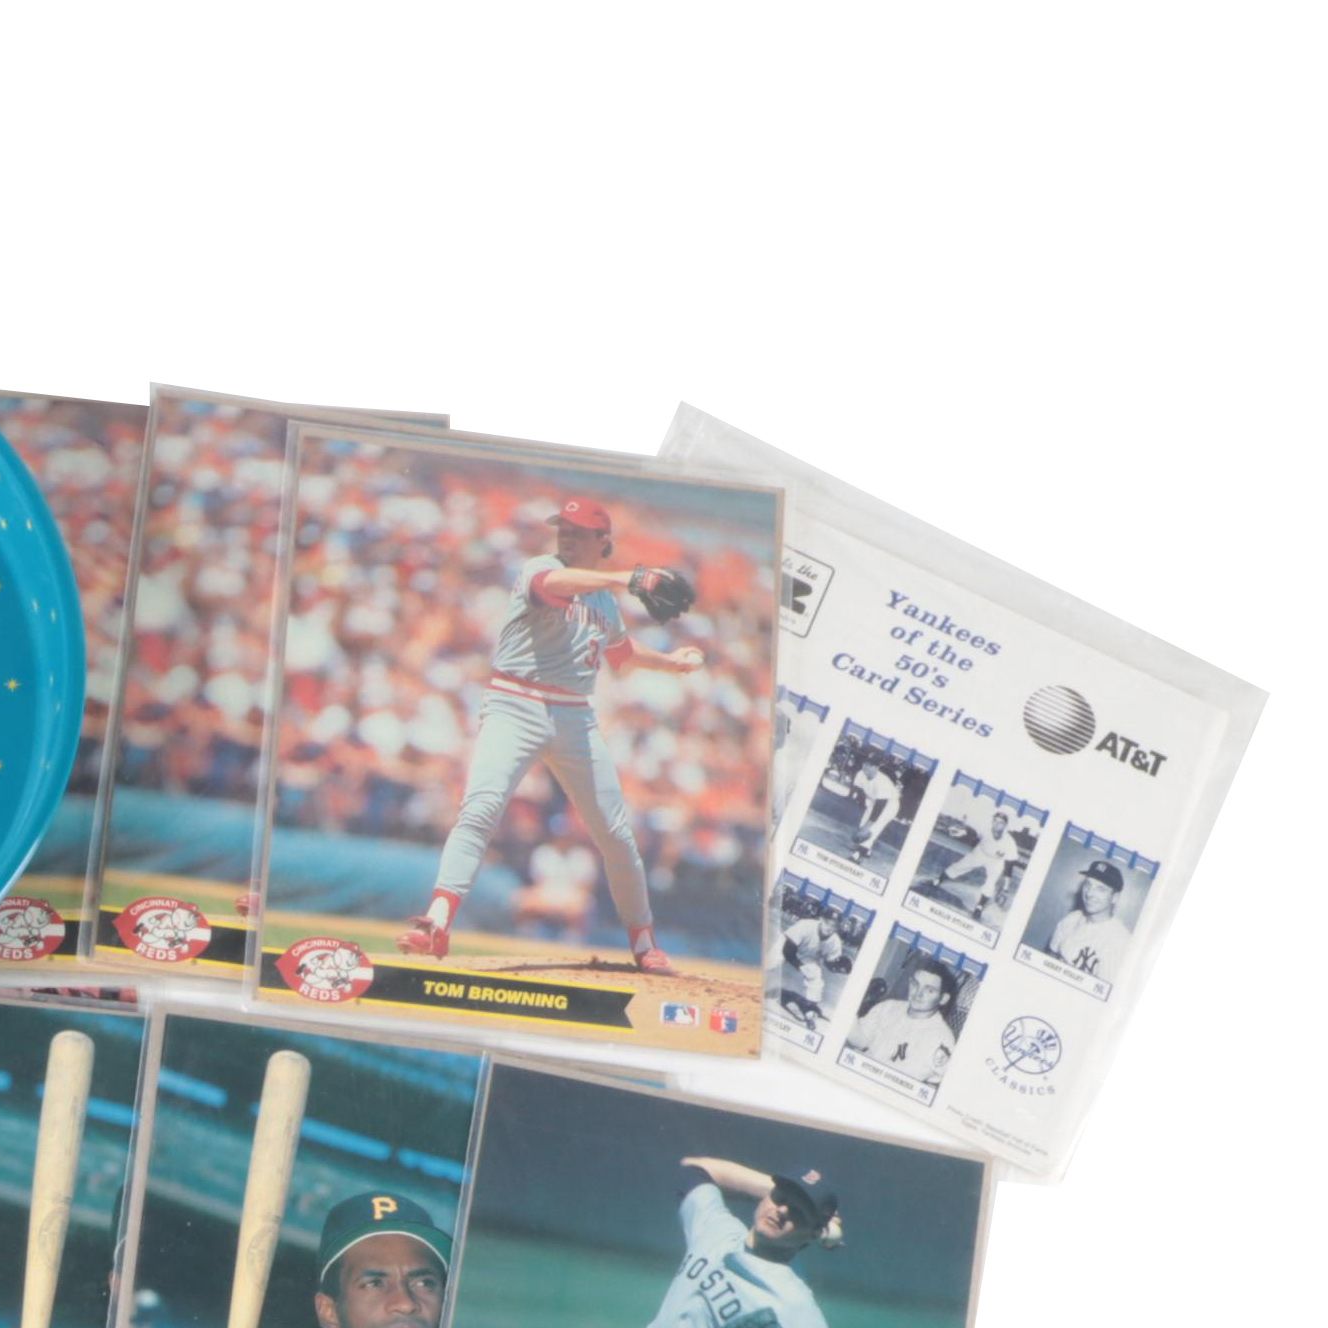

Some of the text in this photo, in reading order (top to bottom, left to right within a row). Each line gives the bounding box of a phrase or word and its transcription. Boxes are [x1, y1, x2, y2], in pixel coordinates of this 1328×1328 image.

[886, 590, 1001, 657] Yankees
[890, 623, 974, 673] of the
[895, 654, 949, 690] 50's
[831, 651, 994, 740] Card Series
[1095, 731, 1168, 778] AT&T
[129, 899, 178, 916] CINCINNATI
[136, 944, 177, 960] REDS
[291, 940, 339, 957] CINCINNATI
[298, 984, 341, 1001] REDS
[424, 980, 568, 1010] TOM BROWNING
[985, 1057, 1056, 1096] CLASSICS
[371, 1196, 398, 1219] P
